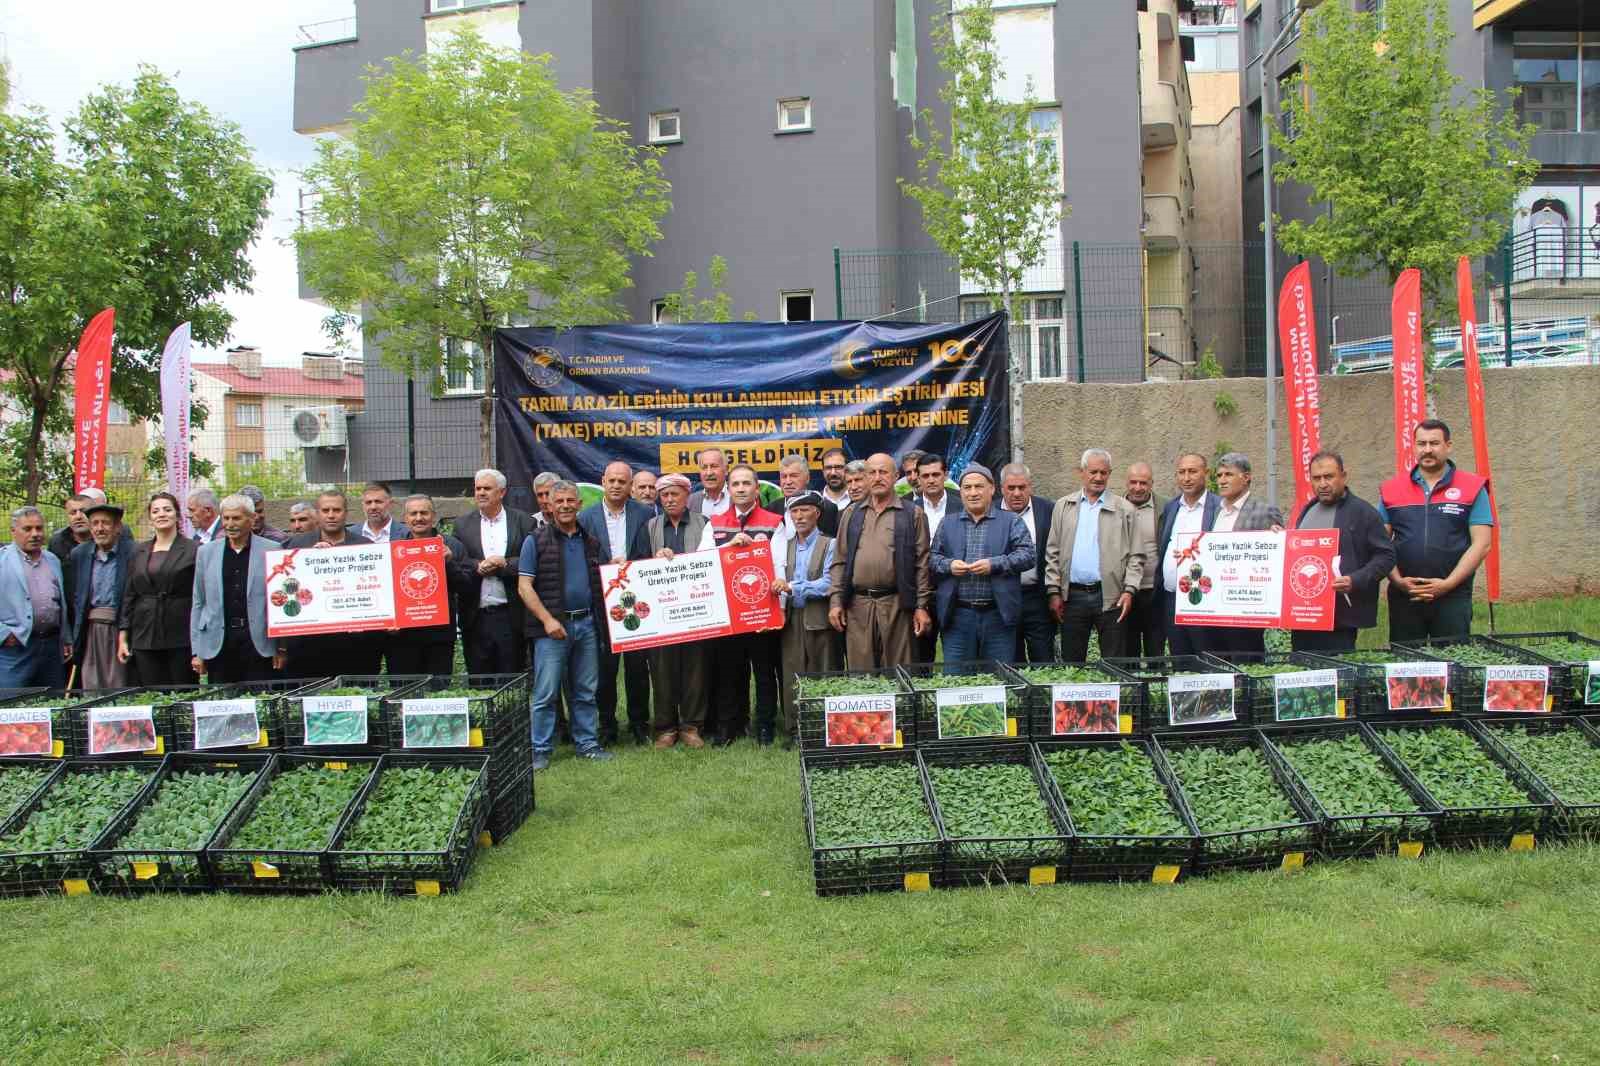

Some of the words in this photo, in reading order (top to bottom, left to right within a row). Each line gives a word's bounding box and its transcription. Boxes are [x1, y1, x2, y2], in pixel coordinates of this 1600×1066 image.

[584, 355, 611, 364] TARIM
[611, 354, 625, 363] VE
[568, 366, 600, 376] ORMAN
[601, 364, 651, 375] BAKANLIĞI
[520, 395, 568, 412] TARIM
[572, 389, 690, 411] ARAZİLERİNİN
[693, 391, 816, 408] KULLANIMININ
[820, 377, 985, 406] ETKİNLEŞTİRİLMESİ
[535, 422, 590, 442] (TAKE)
[593, 416, 663, 438] PROJESİ
[665, 417, 777, 436] KAPSAMINDA
[781, 413, 819, 433] FİDE
[823, 410, 881, 431] TEMİNİ
[886, 405, 969, 428] TÖRENİNE
[1231, 542, 1252, 550] Yazlık
[1254, 541, 1278, 550] Sebze
[304, 556, 330, 566] Şırnak
[332, 554, 357, 564] Yazlık
[358, 553, 383, 562] Sebze
[1244, 552, 1269, 561] Projesi
[313, 565, 346, 576] Üretiyor
[348, 563, 376, 574] Projesi
[638, 568, 662, 578] Şırnak
[665, 564, 688, 574] Yazlık
[689, 560, 713, 569] Sebze
[647, 576, 677, 587] Üretiyor
[680, 572, 707, 583] Projesi
[1489, 669, 1545, 680] DOMATES
[318, 700, 353, 711] HIYAR
[828, 700, 892, 711] DOMATES
